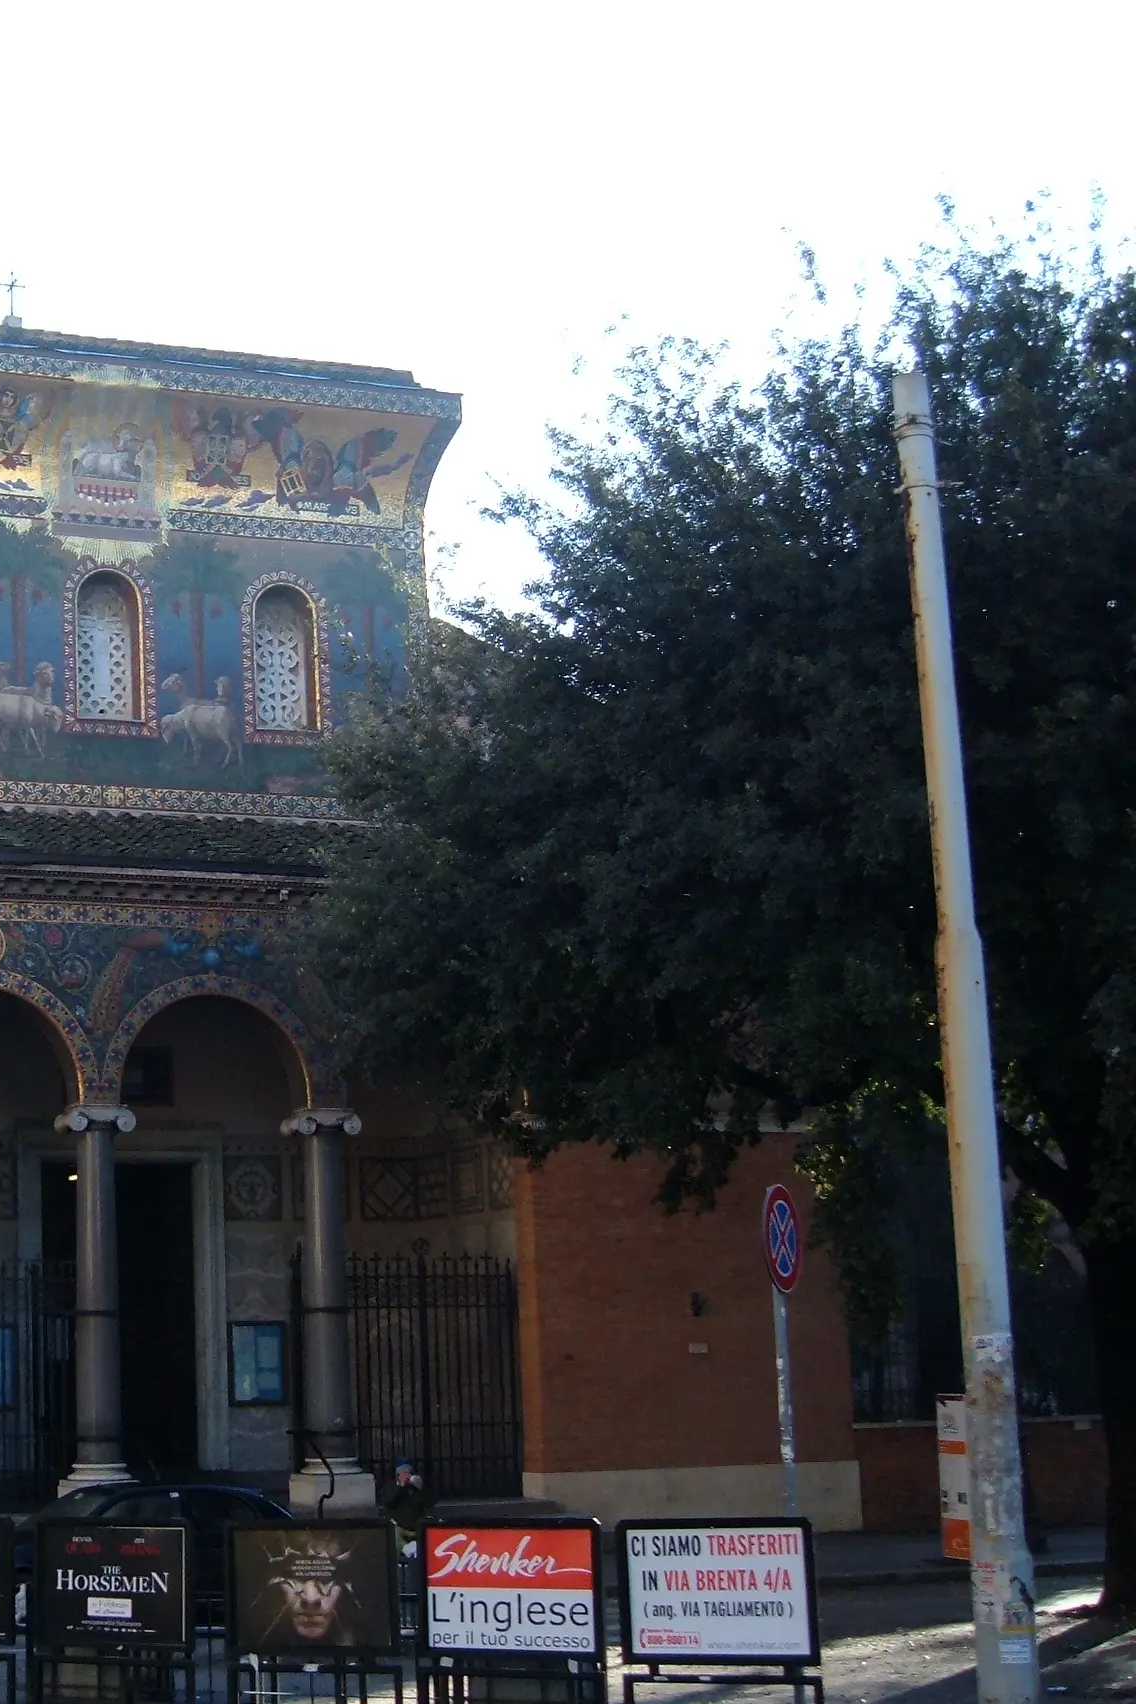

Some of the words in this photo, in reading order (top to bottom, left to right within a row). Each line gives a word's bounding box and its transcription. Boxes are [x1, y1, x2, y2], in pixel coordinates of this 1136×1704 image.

[428, 1533, 591, 1578] Shenker
[631, 1535, 646, 1556] CI
[652, 1535, 701, 1556] SIAMO
[706, 1533, 798, 1556] TRASFERITI
[56, 1568, 169, 1593] HORSEMEN
[101, 1565, 122, 1575] THE
[642, 1570, 658, 1591] IN
[664, 1569, 690, 1591] VIA
[696, 1569, 758, 1591] BRENTA
[763, 1566, 792, 1593] 4/A
[432, 1592, 589, 1632] L'inglese
[681, 1601, 700, 1617] VIA
[703, 1601, 784, 1617] TAGLIAMENTO
[432, 1632, 460, 1647] per
[466, 1631, 474, 1645] il
[481, 1632, 508, 1646] tuo
[514, 1634, 590, 1648] successo
